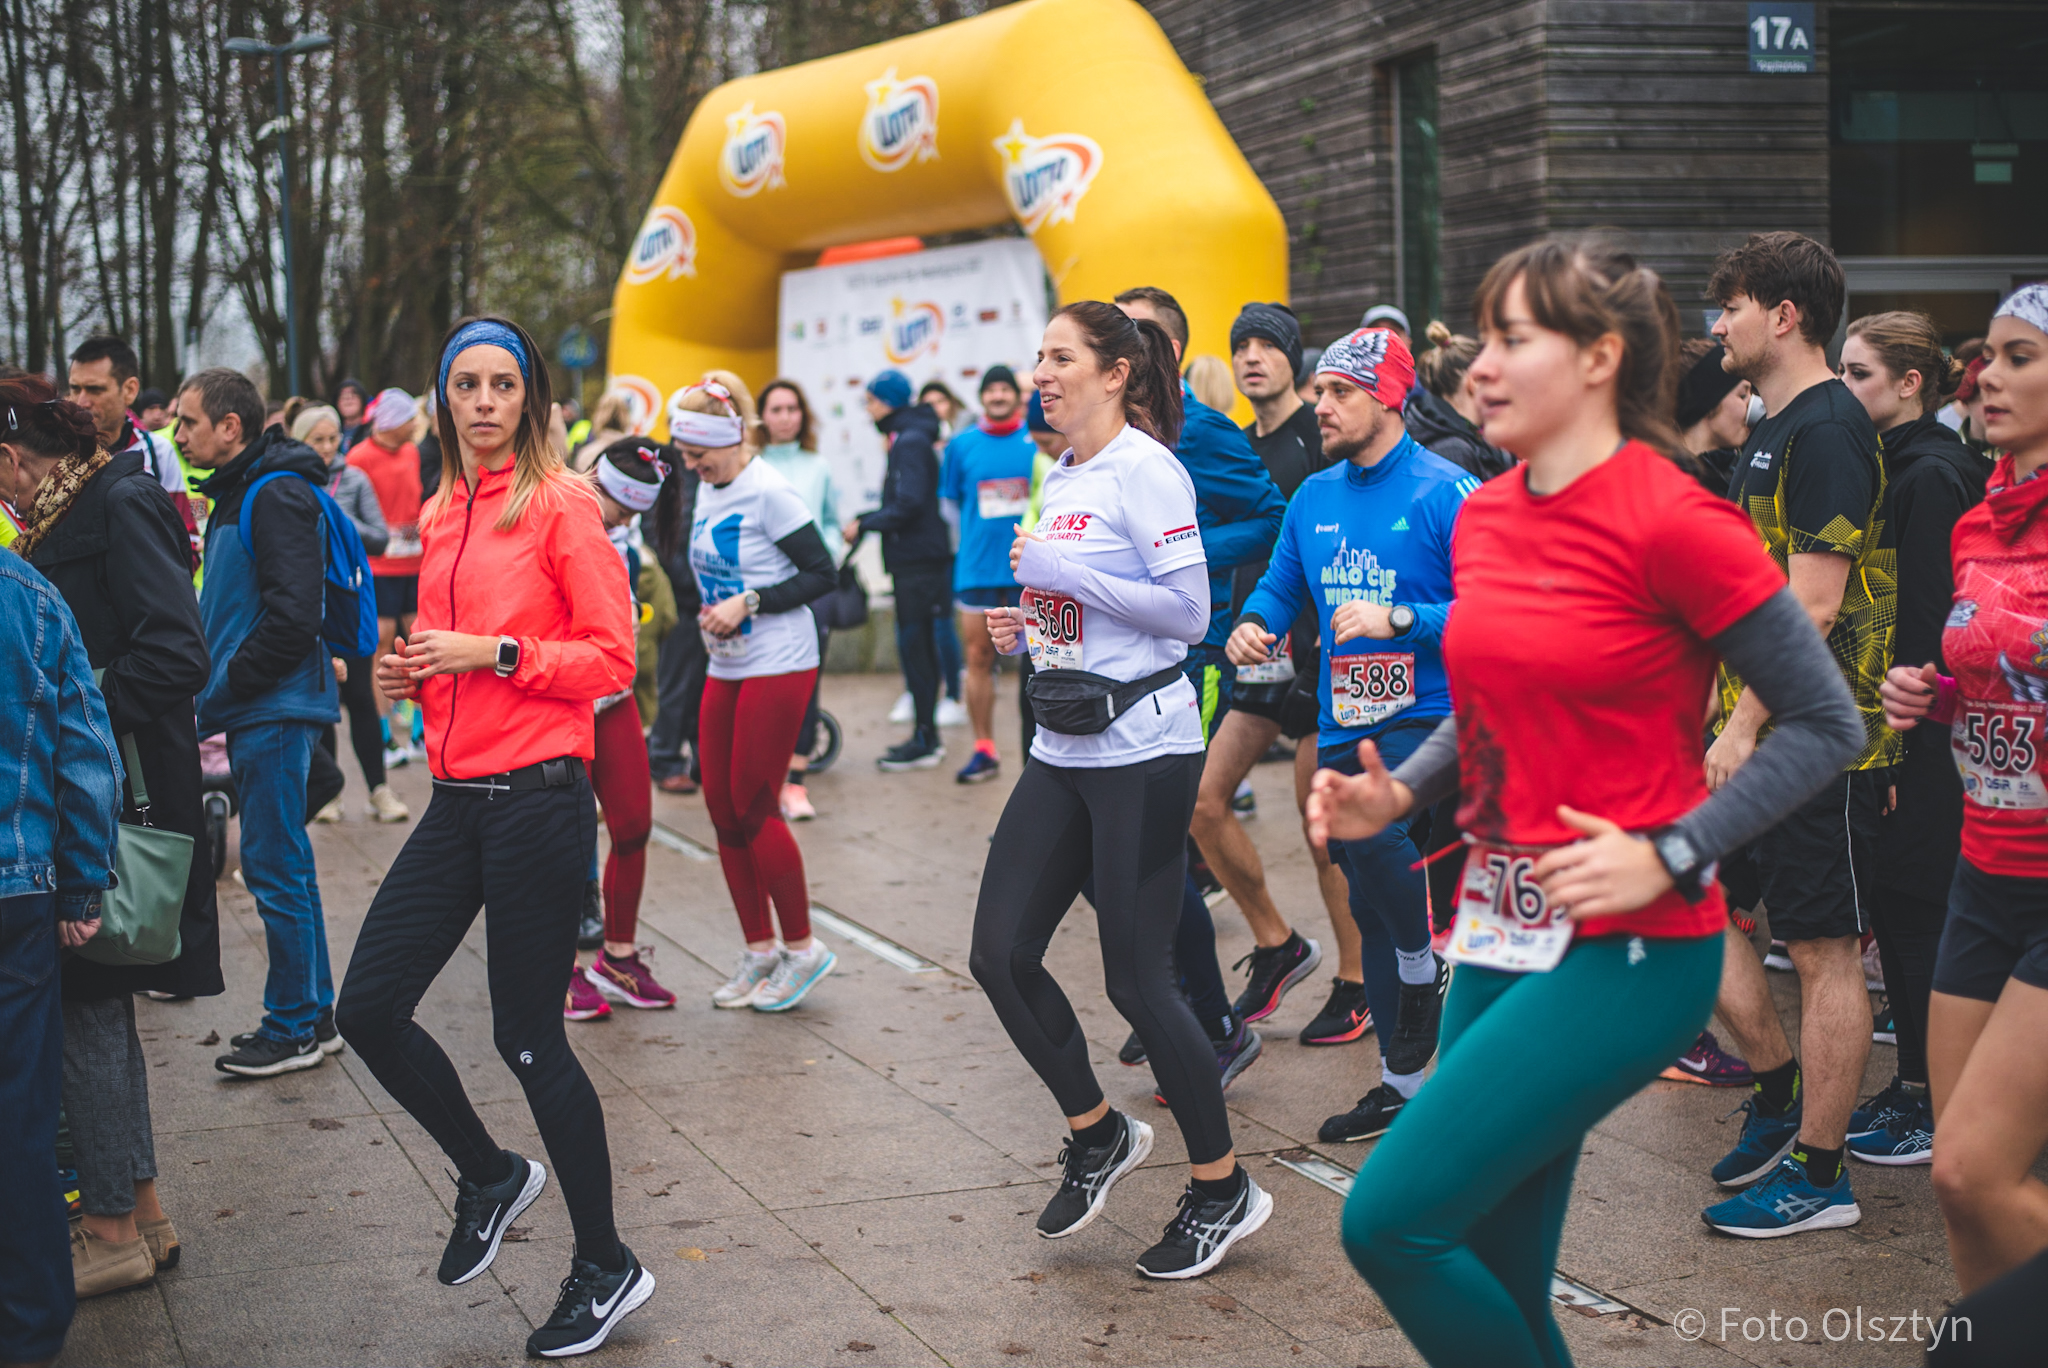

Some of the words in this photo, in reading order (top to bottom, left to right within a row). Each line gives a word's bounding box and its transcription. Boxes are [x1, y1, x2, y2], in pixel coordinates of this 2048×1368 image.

[1750, 15, 1809, 50] 17A
[1049, 514, 1092, 532] RUNS
[1165, 530, 1198, 545] EGGER
[1321, 566, 1363, 586] MIŁO
[1367, 568, 1397, 591] CIĘ
[1034, 597, 1079, 644] 560
[1348, 661, 1410, 700] 588
[1966, 712, 2036, 774] 563
